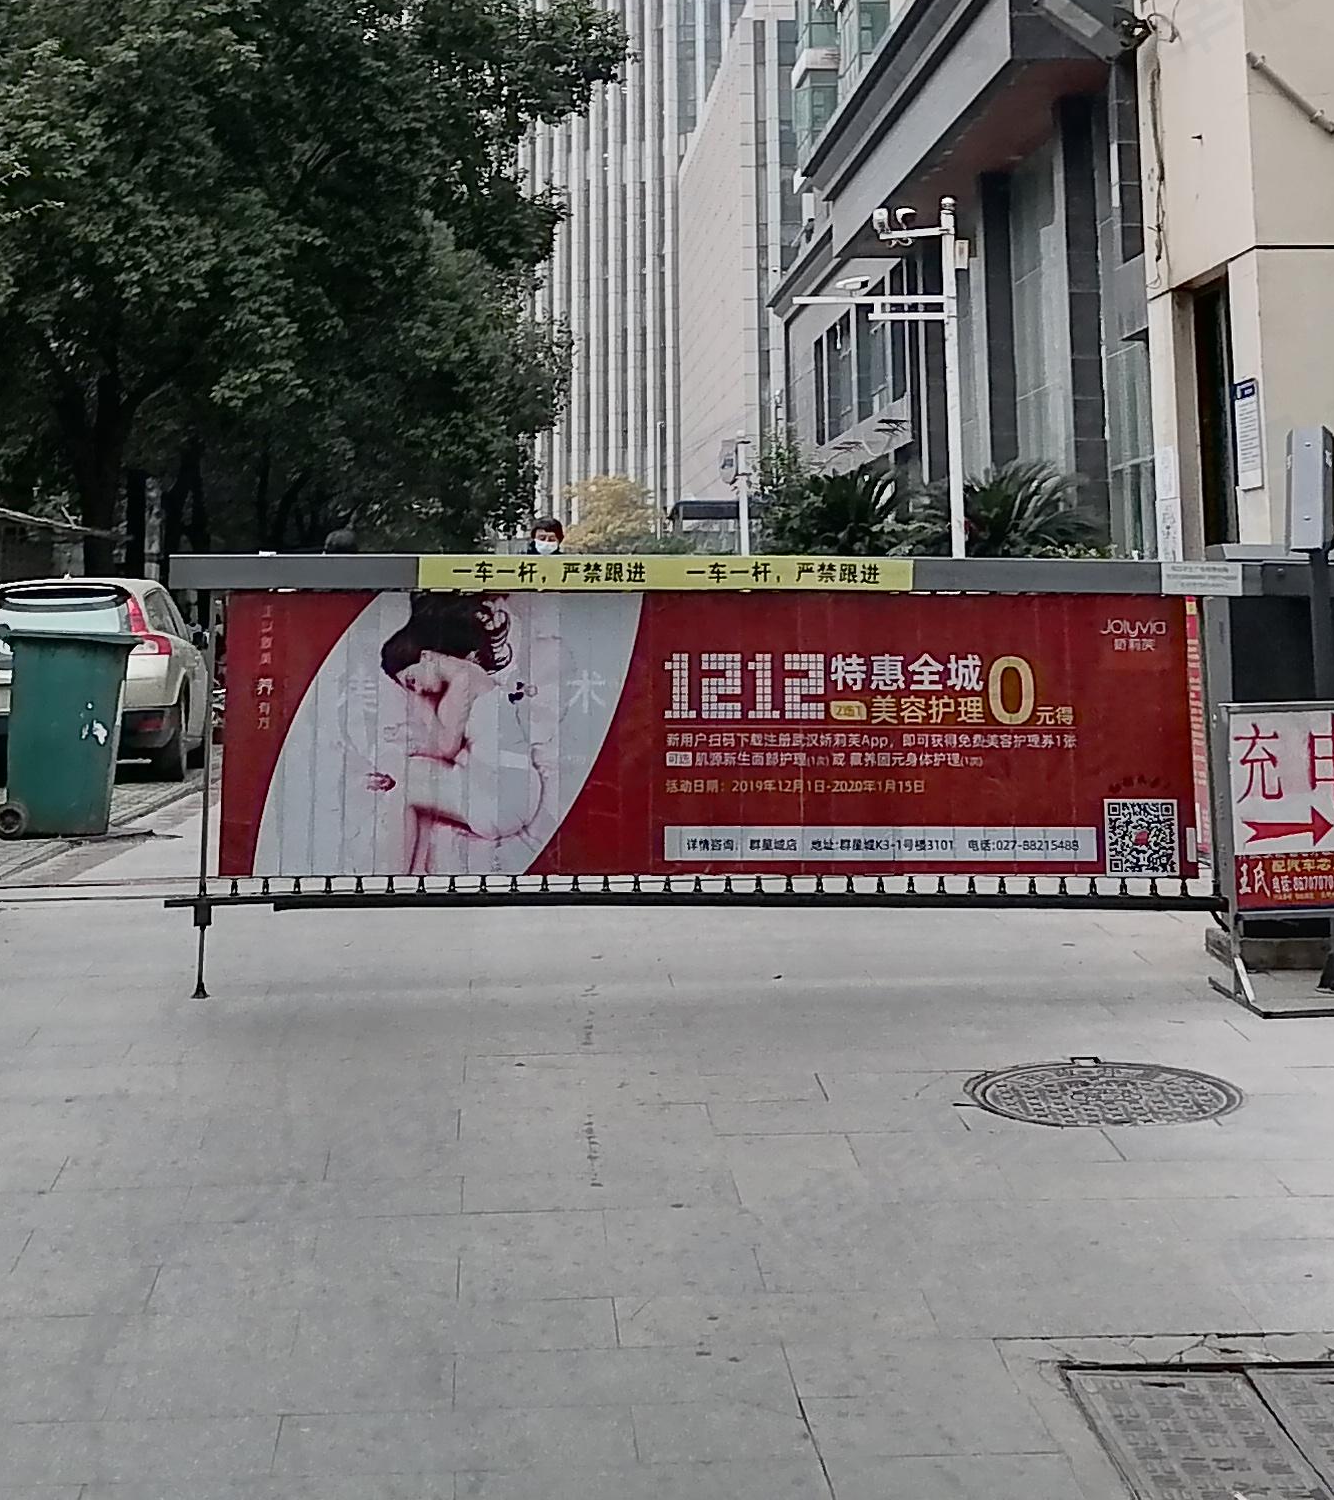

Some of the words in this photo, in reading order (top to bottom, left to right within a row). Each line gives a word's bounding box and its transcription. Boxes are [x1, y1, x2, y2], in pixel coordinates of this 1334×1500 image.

[452, 561, 646, 585] 一车一杆，严禁跟进
[686, 561, 881, 586] 一车一杆，严禁跟进
[664, 653, 825, 719] 1212
[829, 653, 984, 692] 特惠全城
[870, 695, 986, 725] 美容护理
[1238, 860, 1271, 898] 王氏
